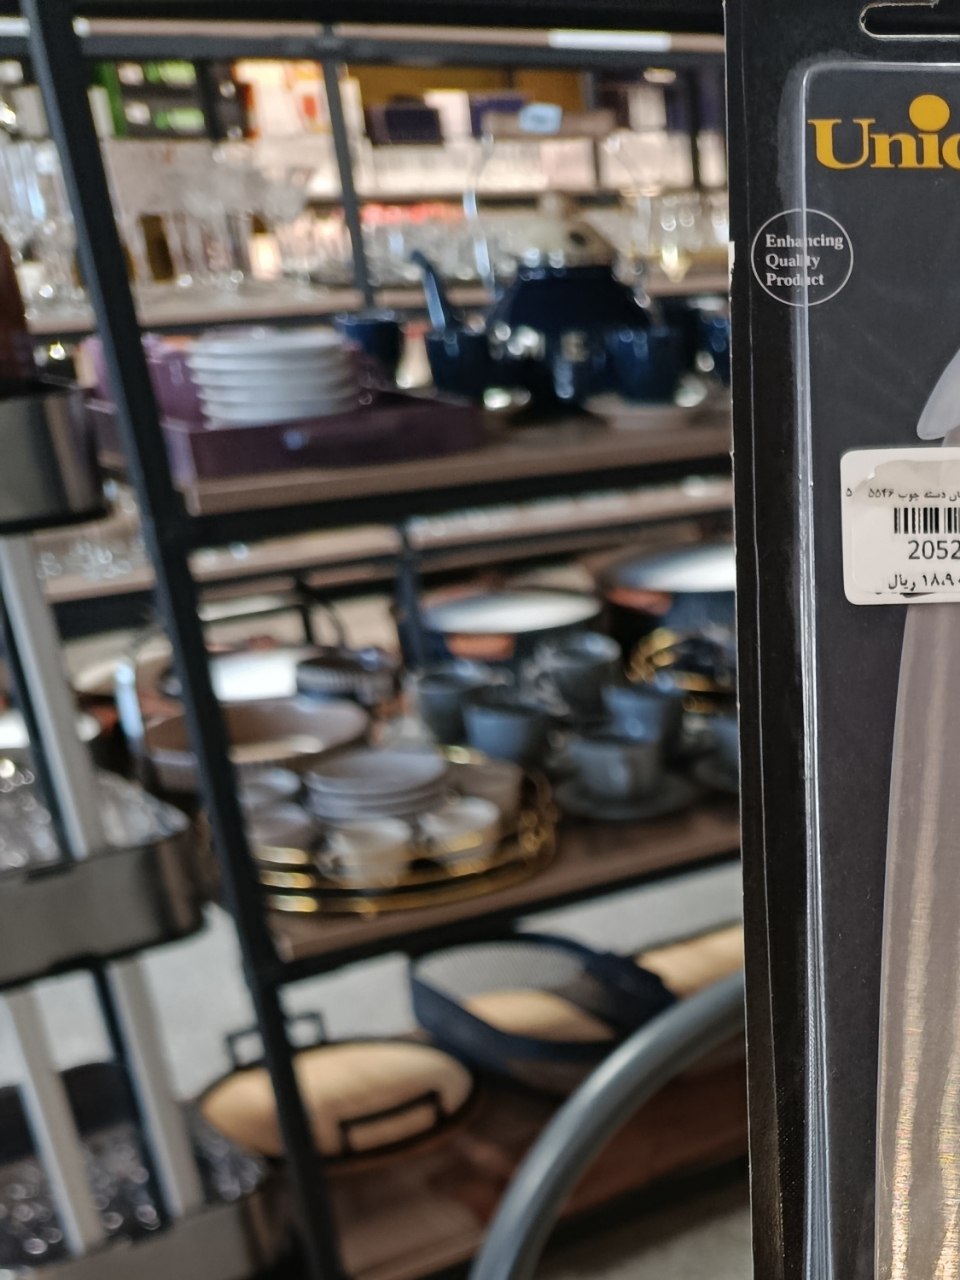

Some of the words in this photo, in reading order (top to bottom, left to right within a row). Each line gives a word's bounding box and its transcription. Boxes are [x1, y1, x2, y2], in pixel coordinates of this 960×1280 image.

[765, 233, 844, 250] Enhancing
[765, 253, 820, 270] Qualty
[924, 490, 946, 499] دسته
[888, 574, 916, 592] ریال
